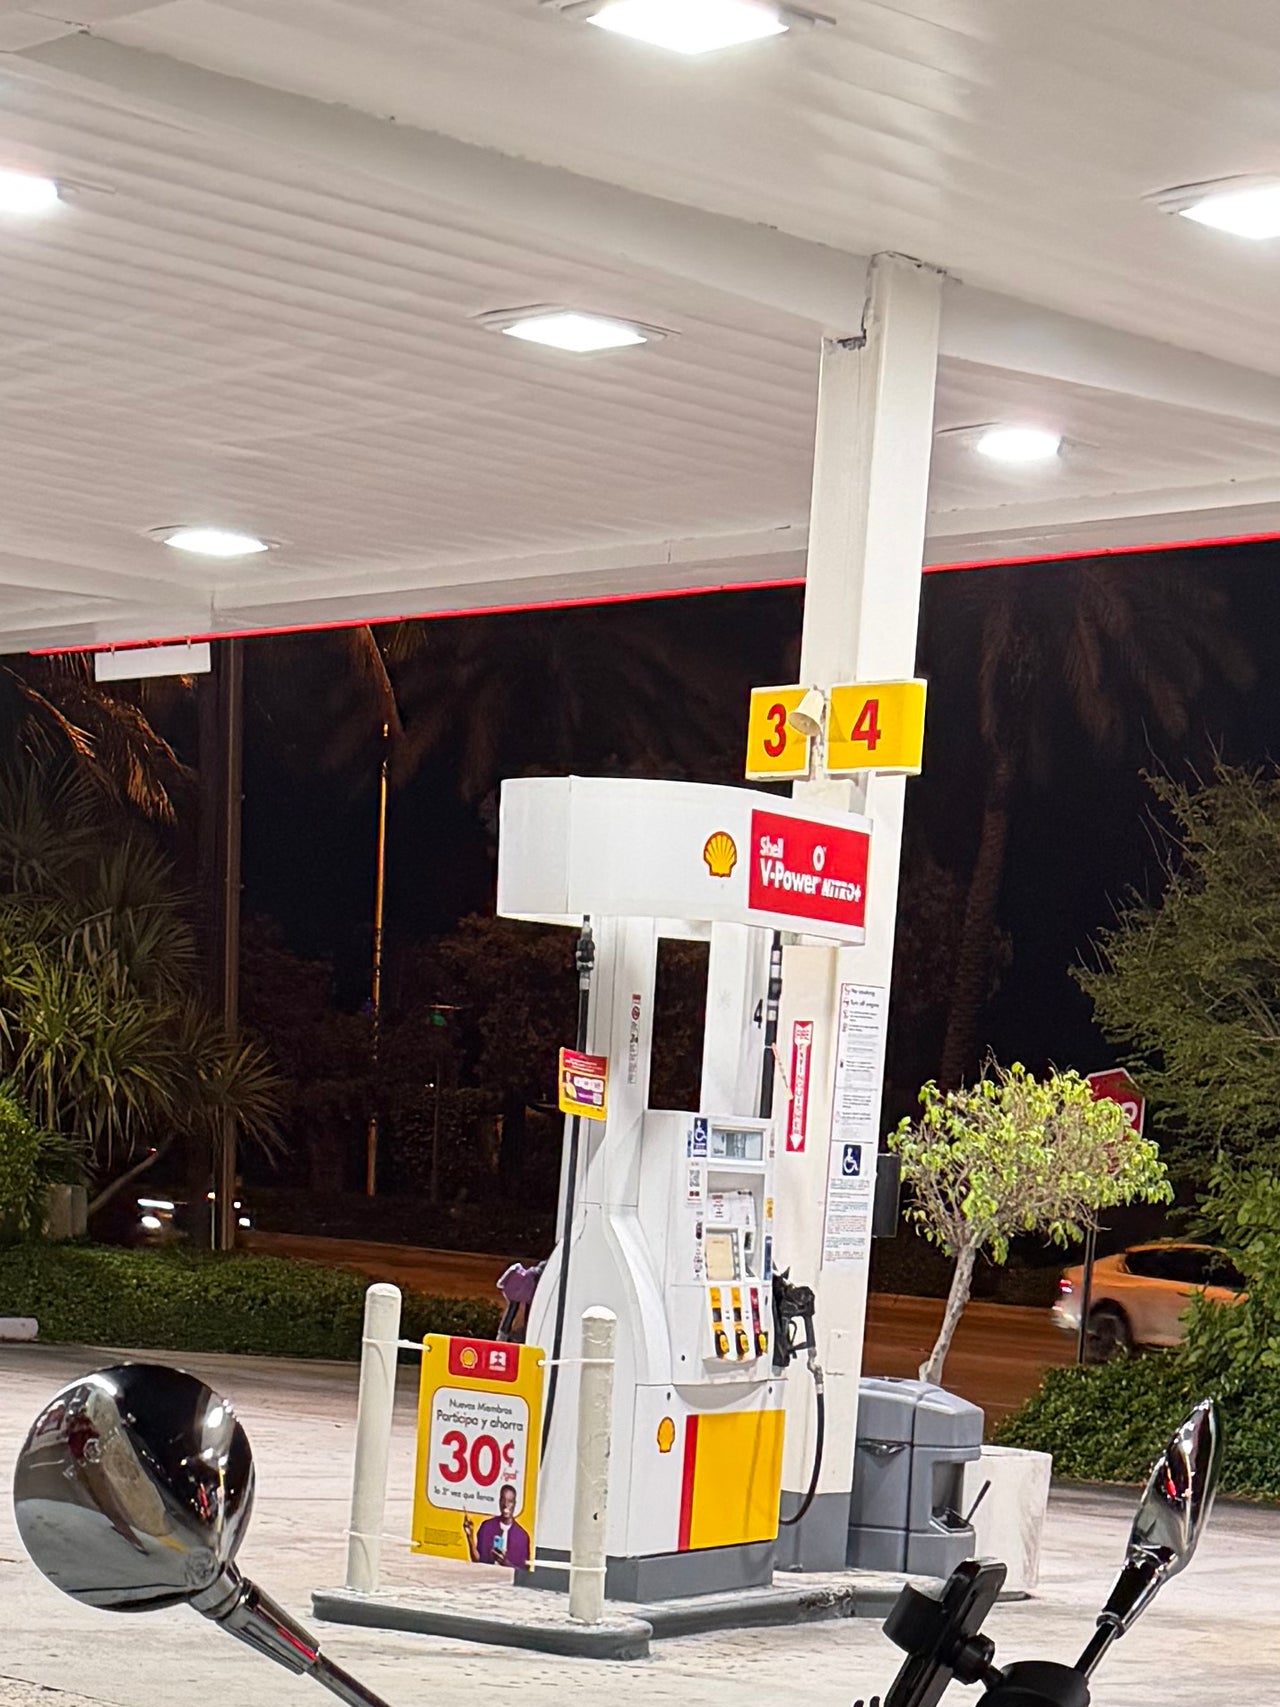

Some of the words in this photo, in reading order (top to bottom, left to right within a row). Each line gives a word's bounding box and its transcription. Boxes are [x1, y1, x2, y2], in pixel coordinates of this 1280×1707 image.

[763, 703, 787, 757] 3
[851, 699, 882, 751] 4
[760, 835, 784, 858] Shell
[760, 858, 819, 895] V-Power
[753, 998, 763, 1030] 4
[436, 1409, 478, 1427] Participa
[481, 1419, 488, 1430] y
[490, 1416, 524, 1431] ahorra
